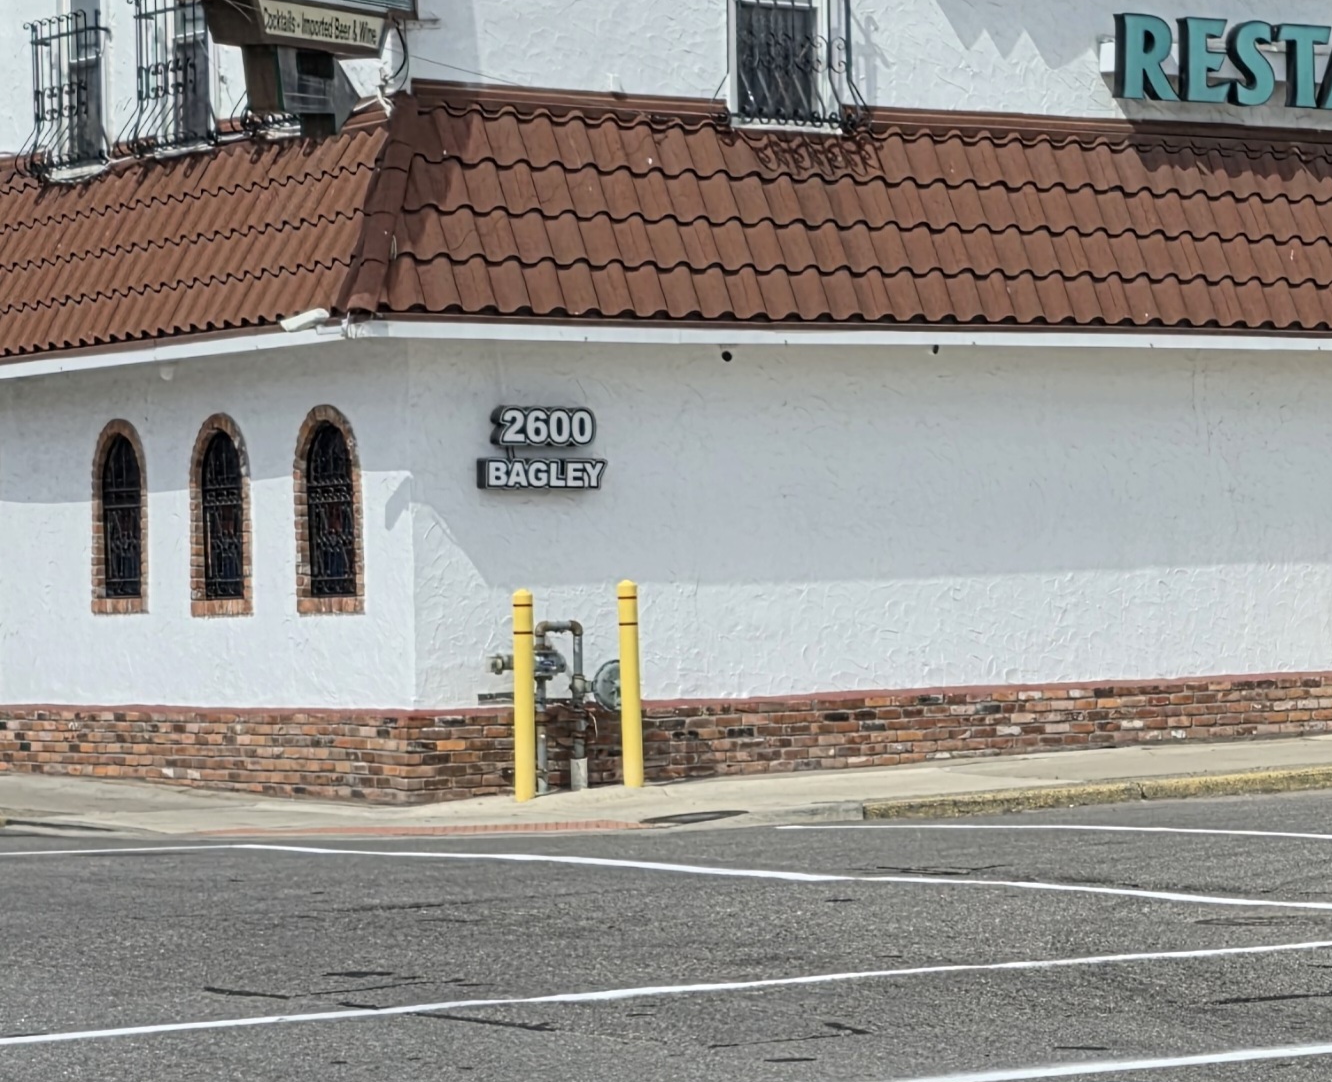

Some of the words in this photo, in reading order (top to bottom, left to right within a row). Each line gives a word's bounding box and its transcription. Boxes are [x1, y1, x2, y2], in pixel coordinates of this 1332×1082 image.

[264, 6, 296, 34] Cocktails
[301, 11, 333, 39] Imported
[334, 16, 352, 41] Beer
[359, 21, 377, 46] Wine
[499, 406, 596, 446] 2600
[484, 458, 608, 490] BAGLEY
